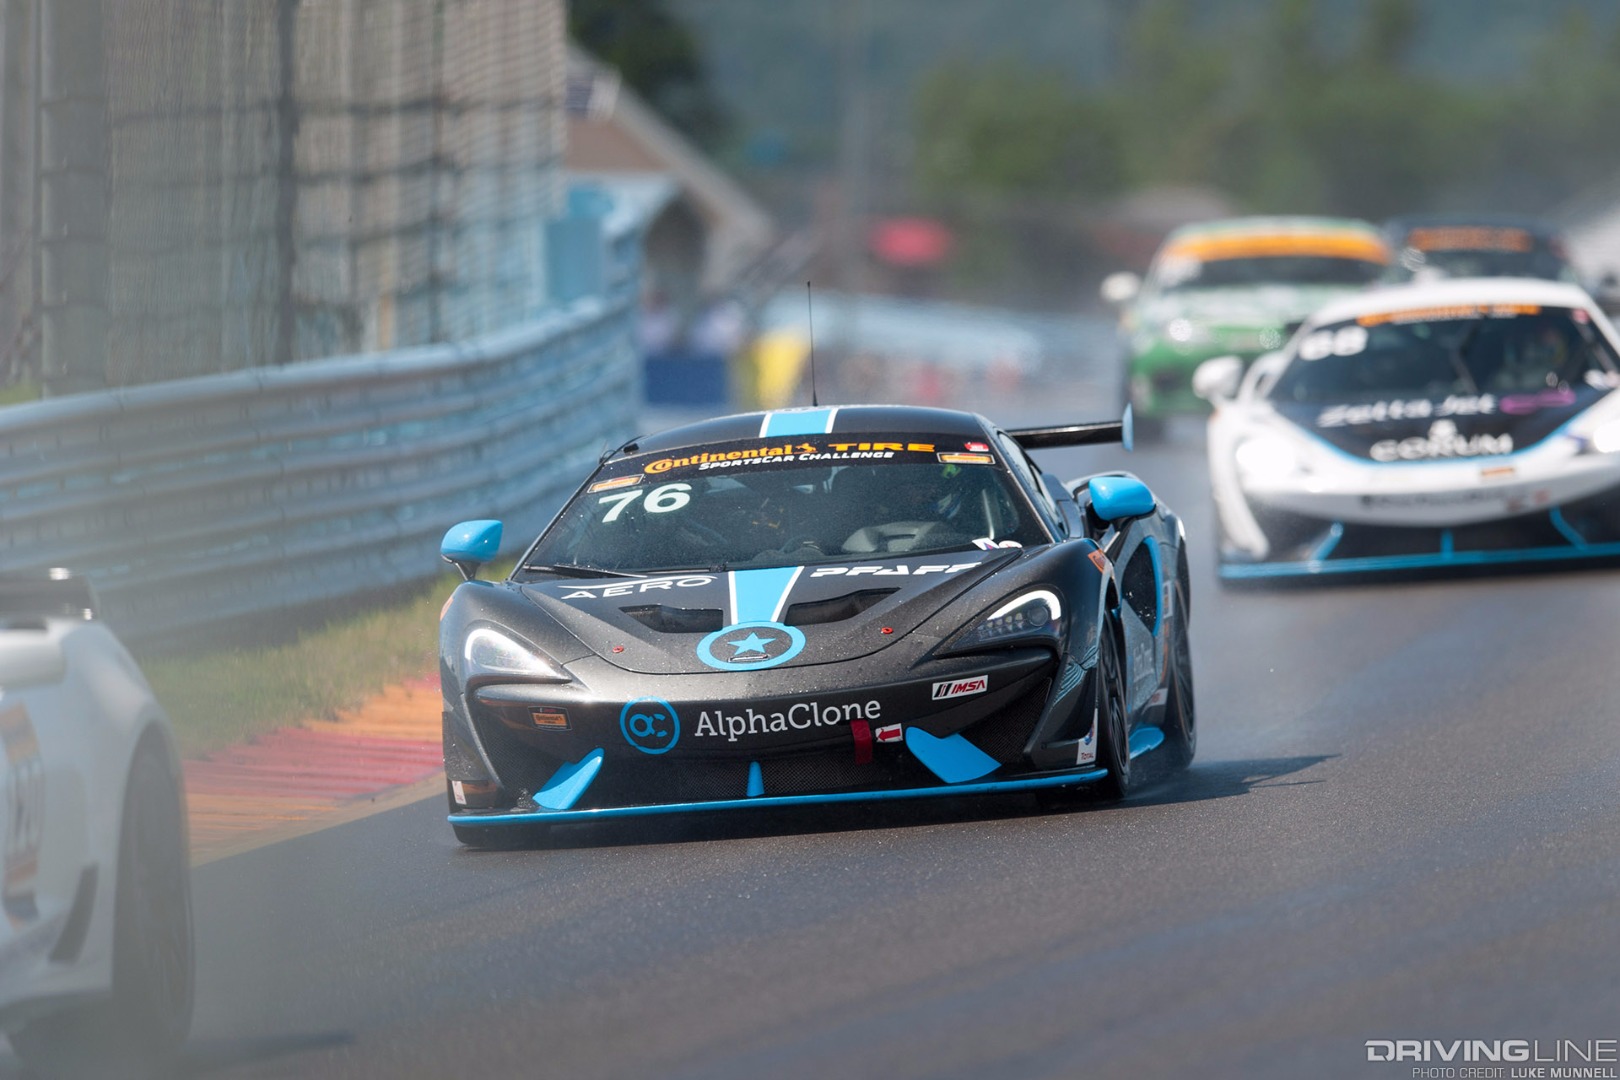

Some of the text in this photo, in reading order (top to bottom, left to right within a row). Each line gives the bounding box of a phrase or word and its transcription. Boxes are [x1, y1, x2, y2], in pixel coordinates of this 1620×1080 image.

[644, 442, 936, 474] Continental TIRE
[798, 452, 895, 461] CHALLENGE
[598, 482, 692, 523] 76
[810, 562, 983, 579] PFAFF
[561, 576, 713, 600] AERO
[951, 679, 985, 695] IMSA
[695, 700, 881, 742] AlphaClone
